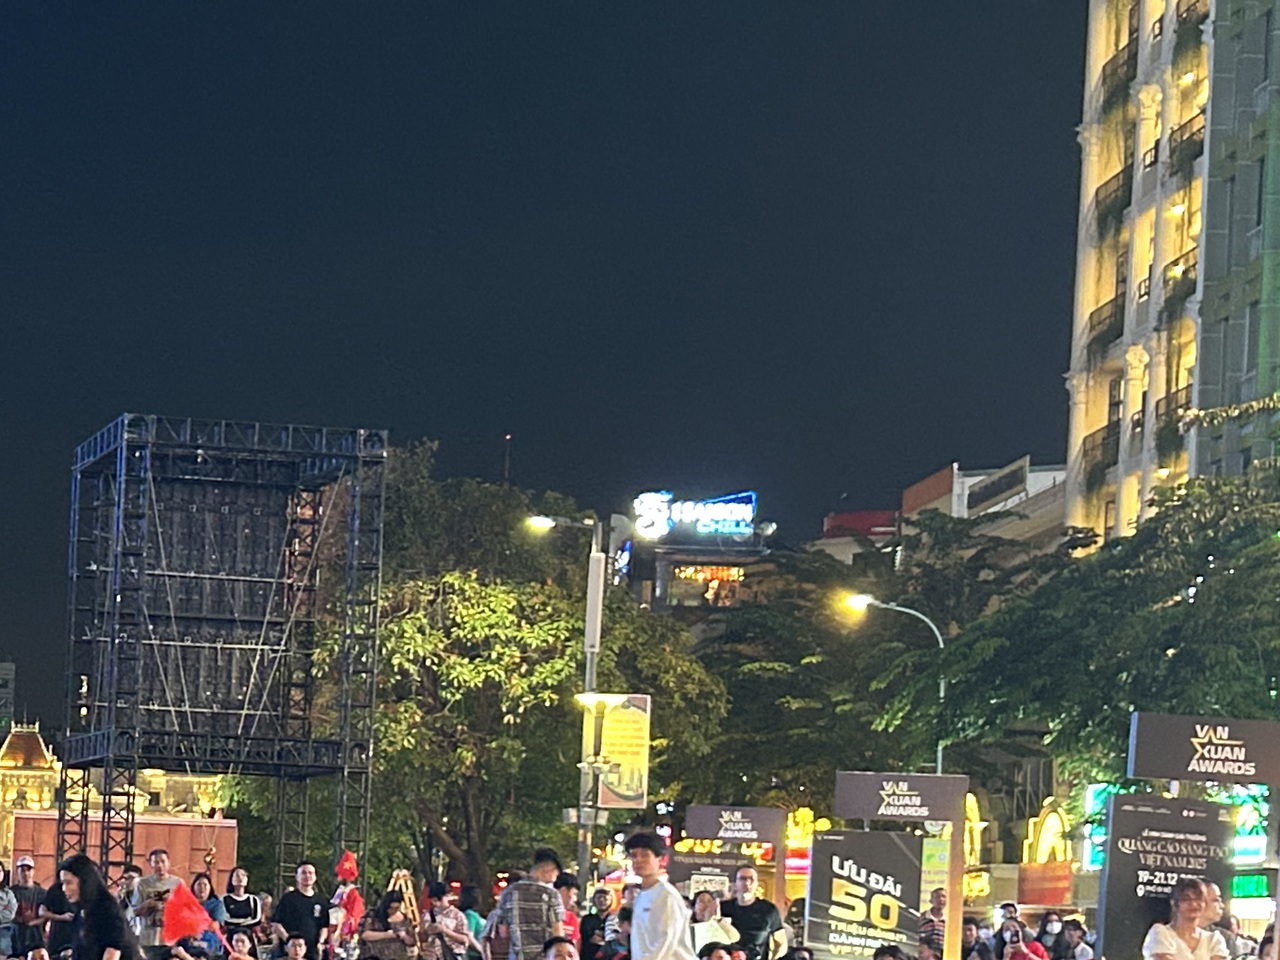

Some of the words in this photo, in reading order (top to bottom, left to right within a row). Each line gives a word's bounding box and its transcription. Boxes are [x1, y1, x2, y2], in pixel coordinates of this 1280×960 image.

[696, 519, 753, 534] CHILL
[1195, 724, 1229, 740] VAN
[1193, 745, 1246, 760] XUAN
[1188, 760, 1255, 775] AWARDS
[882, 781, 908, 792] VAN
[881, 796, 921, 806] XUAN
[877, 806, 929, 816] AWARDS
[832, 855, 867, 883] ƯU
[868, 872, 902, 897] ĐÃI
[828, 877, 899, 929] 50
